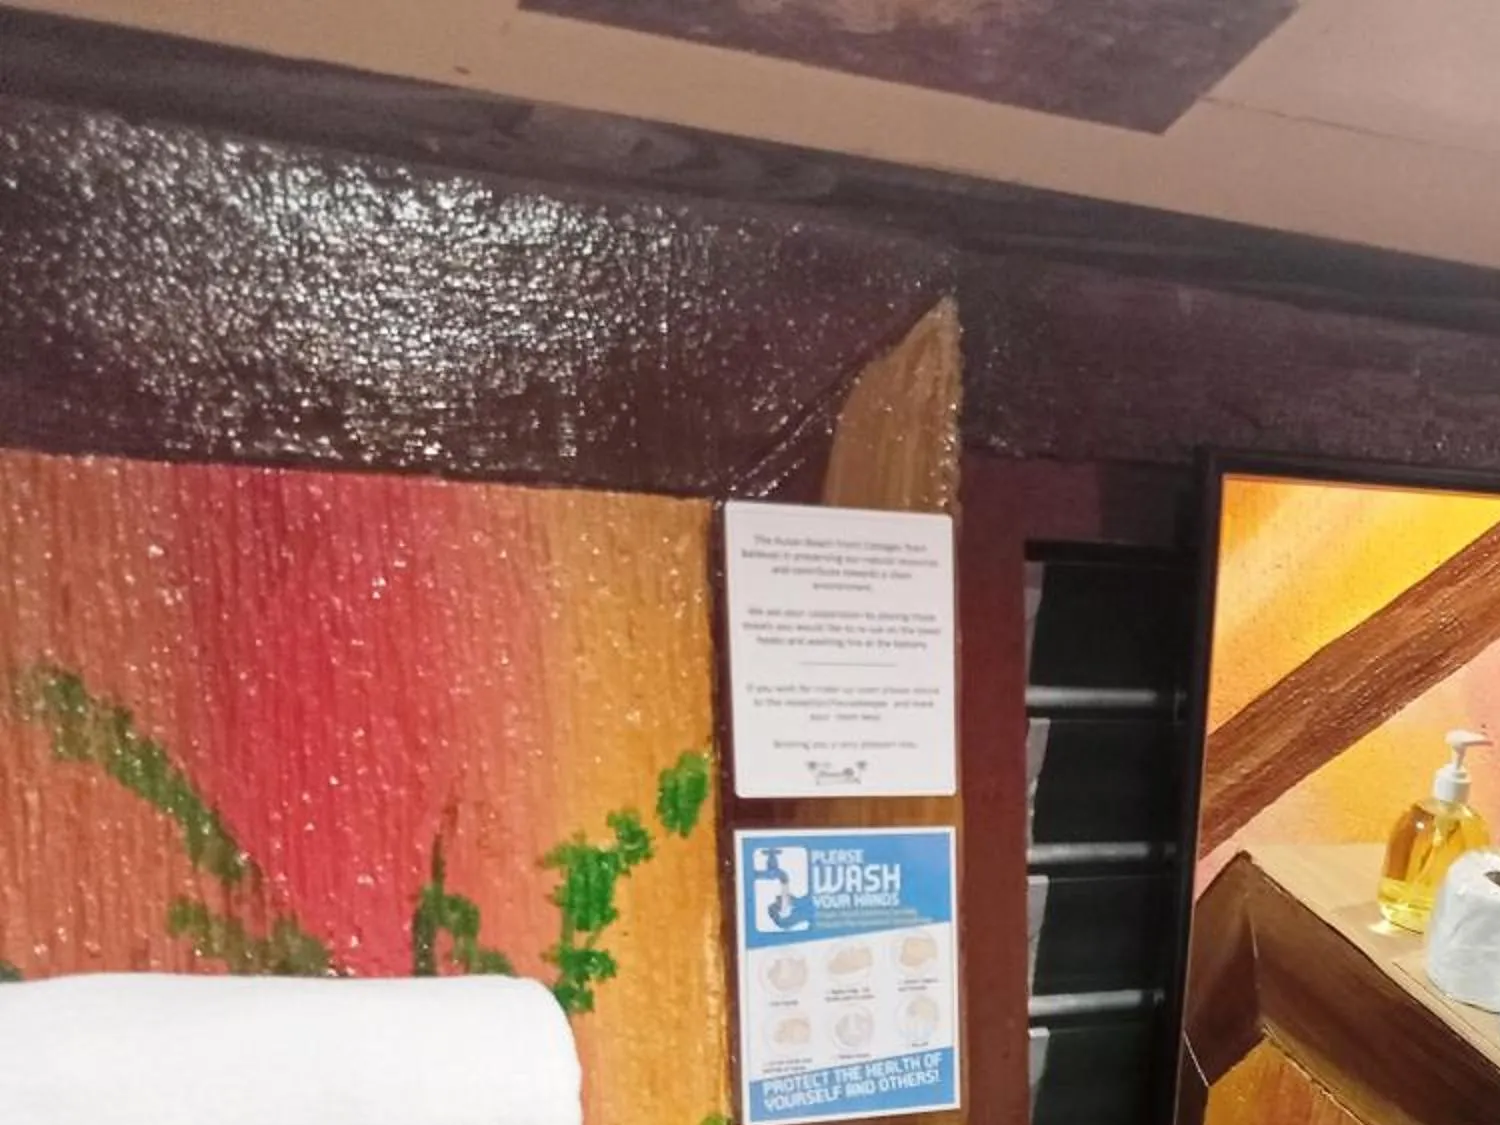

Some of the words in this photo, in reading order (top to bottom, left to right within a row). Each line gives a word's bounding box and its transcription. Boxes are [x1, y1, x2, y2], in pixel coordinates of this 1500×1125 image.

[812, 864, 901, 893] WASH
[813, 893, 852, 909] YOUR
[854, 891, 900, 907] HANDS
[762, 1071, 831, 1096] PROTECT
[834, 1064, 863, 1083] THE
[865, 1054, 922, 1079] HEALTH
[923, 1052, 942, 1068] OF
[763, 1086, 841, 1112] YOURSELF
[845, 1080, 876, 1098] AND
